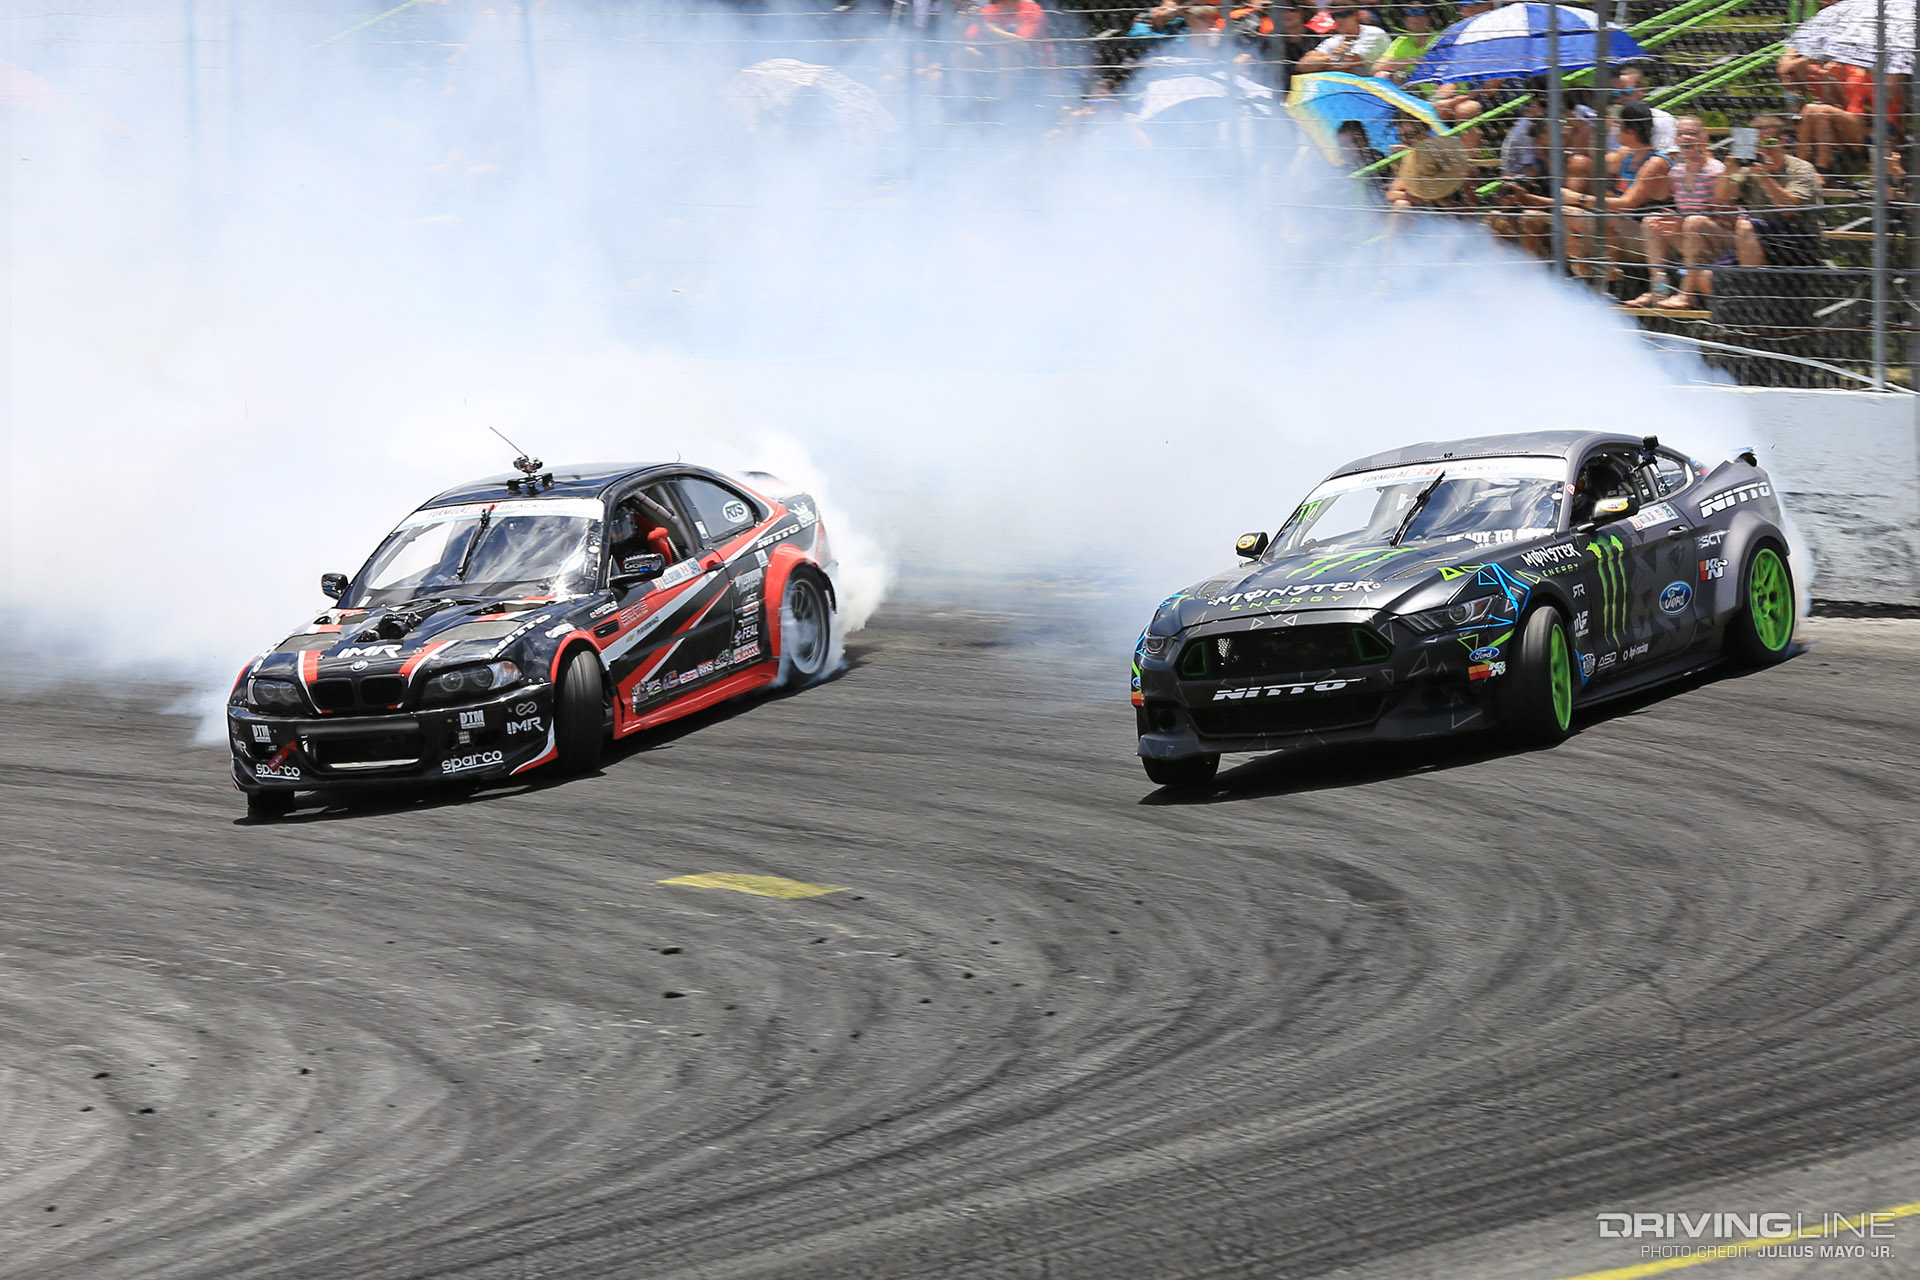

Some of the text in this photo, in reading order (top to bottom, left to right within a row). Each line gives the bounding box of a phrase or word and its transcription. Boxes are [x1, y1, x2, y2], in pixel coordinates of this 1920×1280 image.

[1699, 481, 1771, 519] NITTO
[757, 523, 800, 549] NITTO
[1541, 562, 1579, 578] ENERGY
[1207, 580, 1375, 606] MONSTER
[1230, 595, 1345, 611] ENERGY
[1664, 586, 1686, 609] Ford
[336, 644, 402, 659] IMR
[1212, 679, 1367, 701] NITTO
[459, 709, 484, 724] DTM
[506, 716, 544, 735] IMR
[255, 763, 301, 780] sparco
[441, 750, 504, 774] sparco
